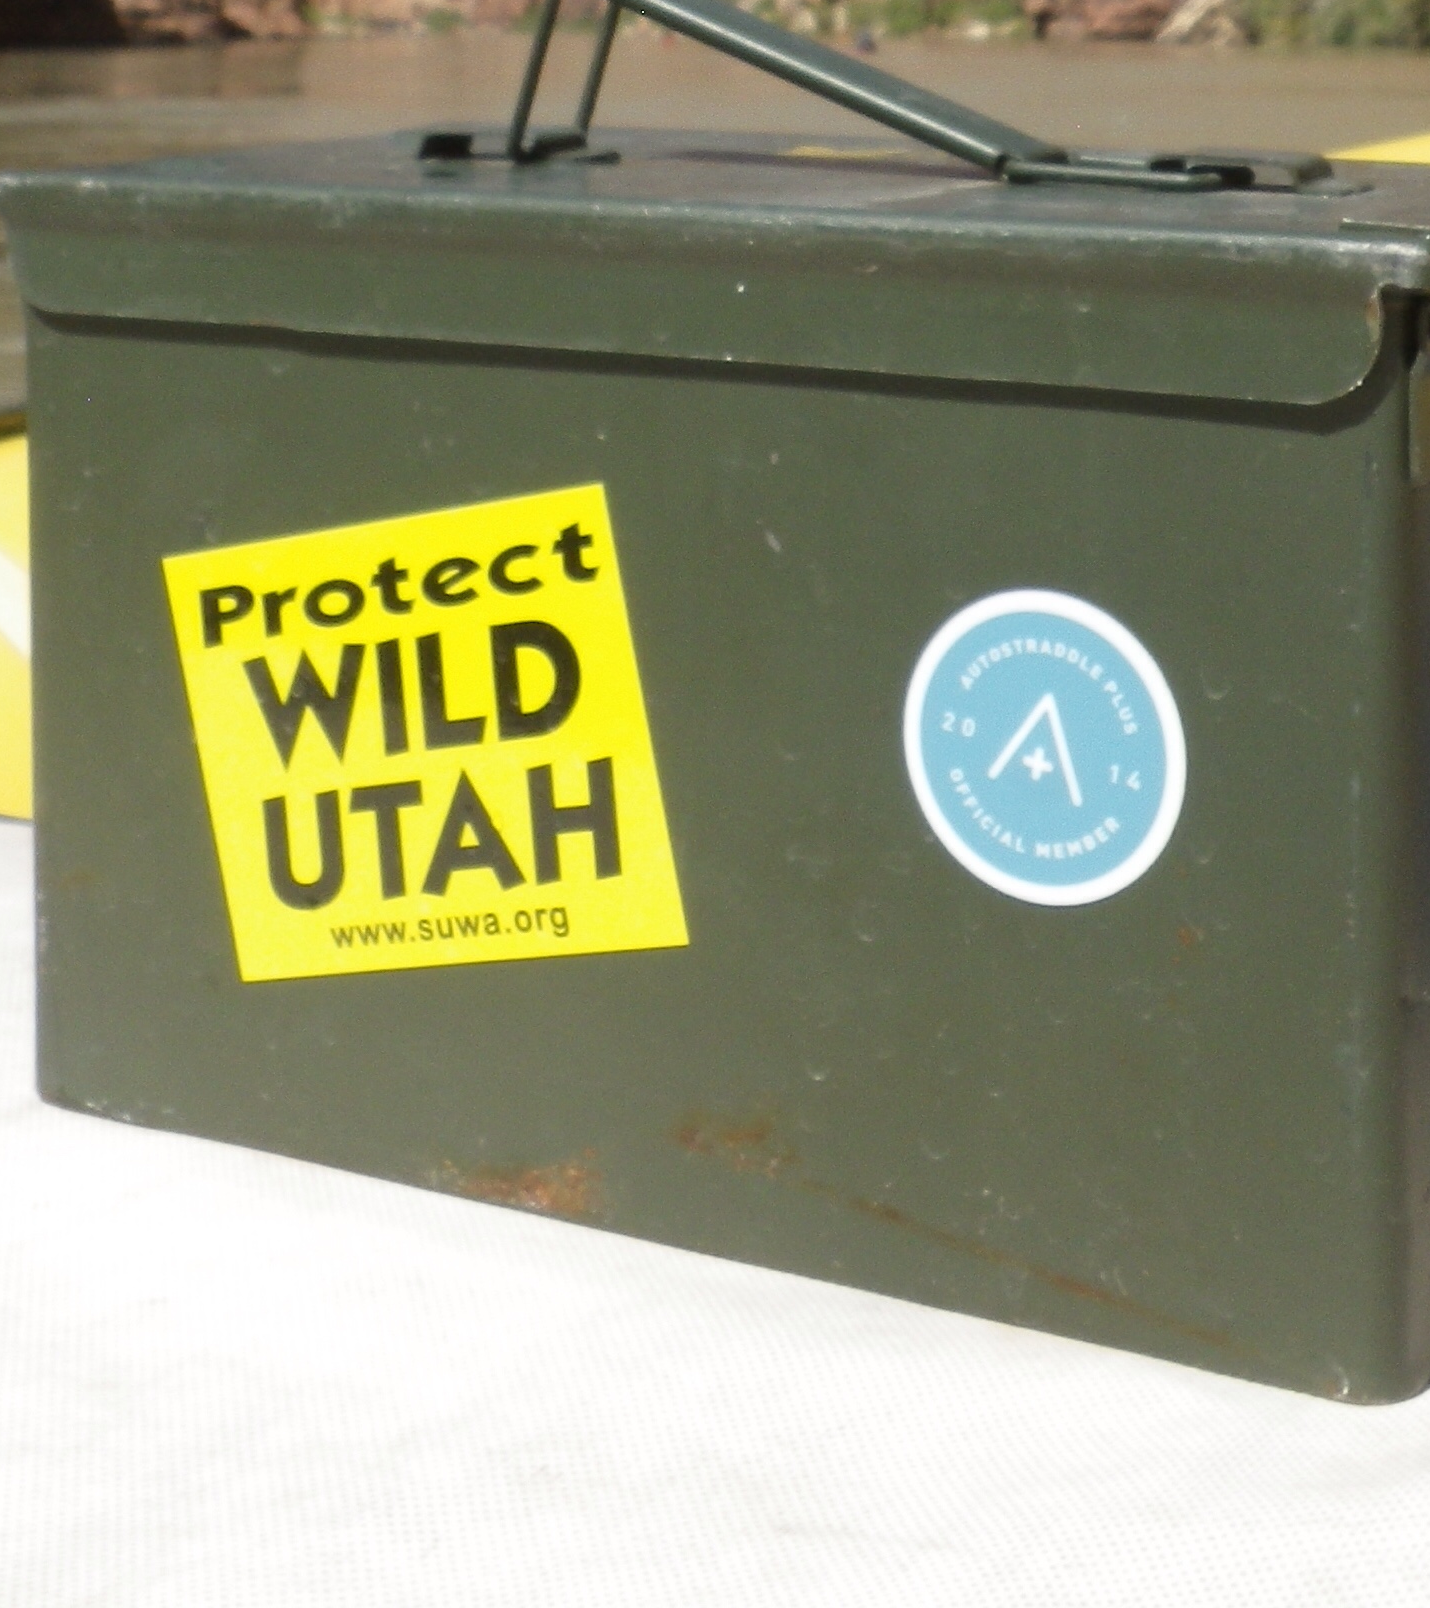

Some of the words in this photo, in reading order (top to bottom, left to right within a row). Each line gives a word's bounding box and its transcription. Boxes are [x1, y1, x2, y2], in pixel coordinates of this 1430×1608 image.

[199, 523, 599, 648] Protect
[243, 619, 582, 772] WILD
[960, 638, 1103, 690] AUTOSTRADDLE
[1103, 680, 1138, 734] PLUS
[263, 756, 623, 911] UTAH
[950, 768, 1025, 854] OFFICIAL
[1034, 817, 1120, 860] MEMBER
[330, 905, 570, 949] www.suwa.org
